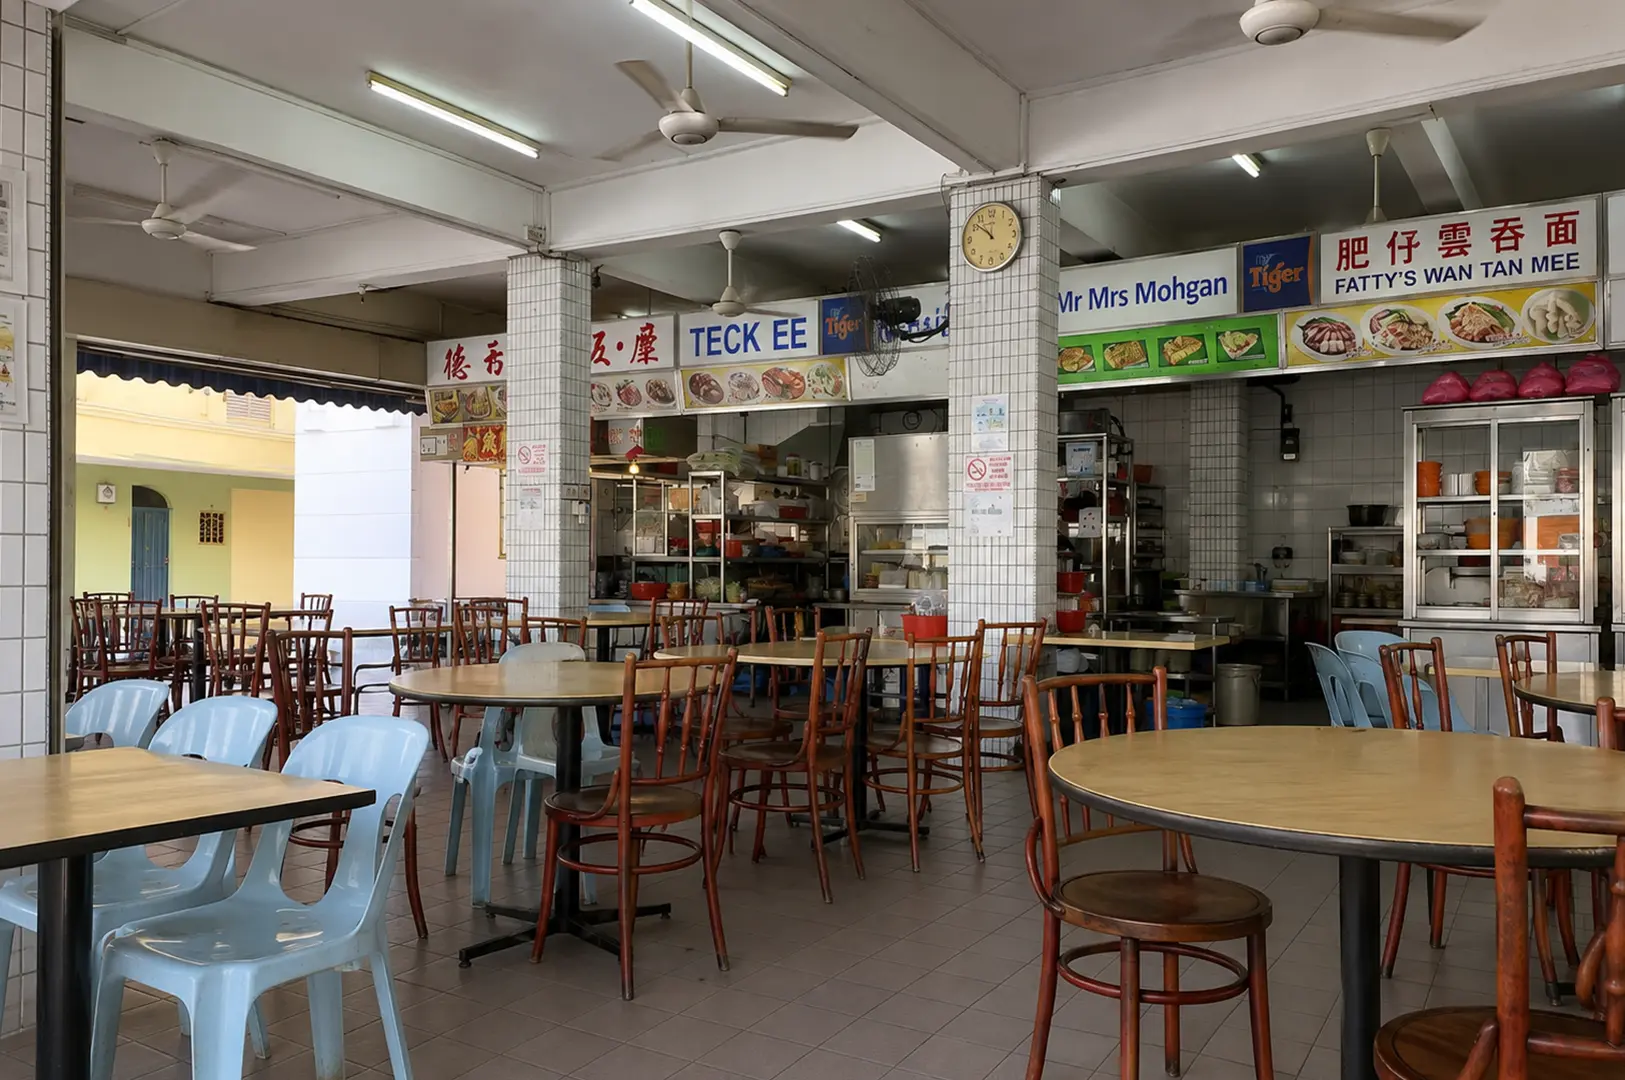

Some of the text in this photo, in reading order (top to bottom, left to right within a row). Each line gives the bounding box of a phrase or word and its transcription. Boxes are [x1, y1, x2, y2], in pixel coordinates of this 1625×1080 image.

[1336, 210, 1581, 272] 肥仔雲吞面
[1249, 261, 1305, 294] Tiger
[1335, 252, 1580, 295] FATTY'S WAN TAN MEE
[1057, 275, 1228, 313] Mr Mrs Mohgan
[690, 317, 808, 357] TECK EE
[825, 314, 861, 340] Tiger
